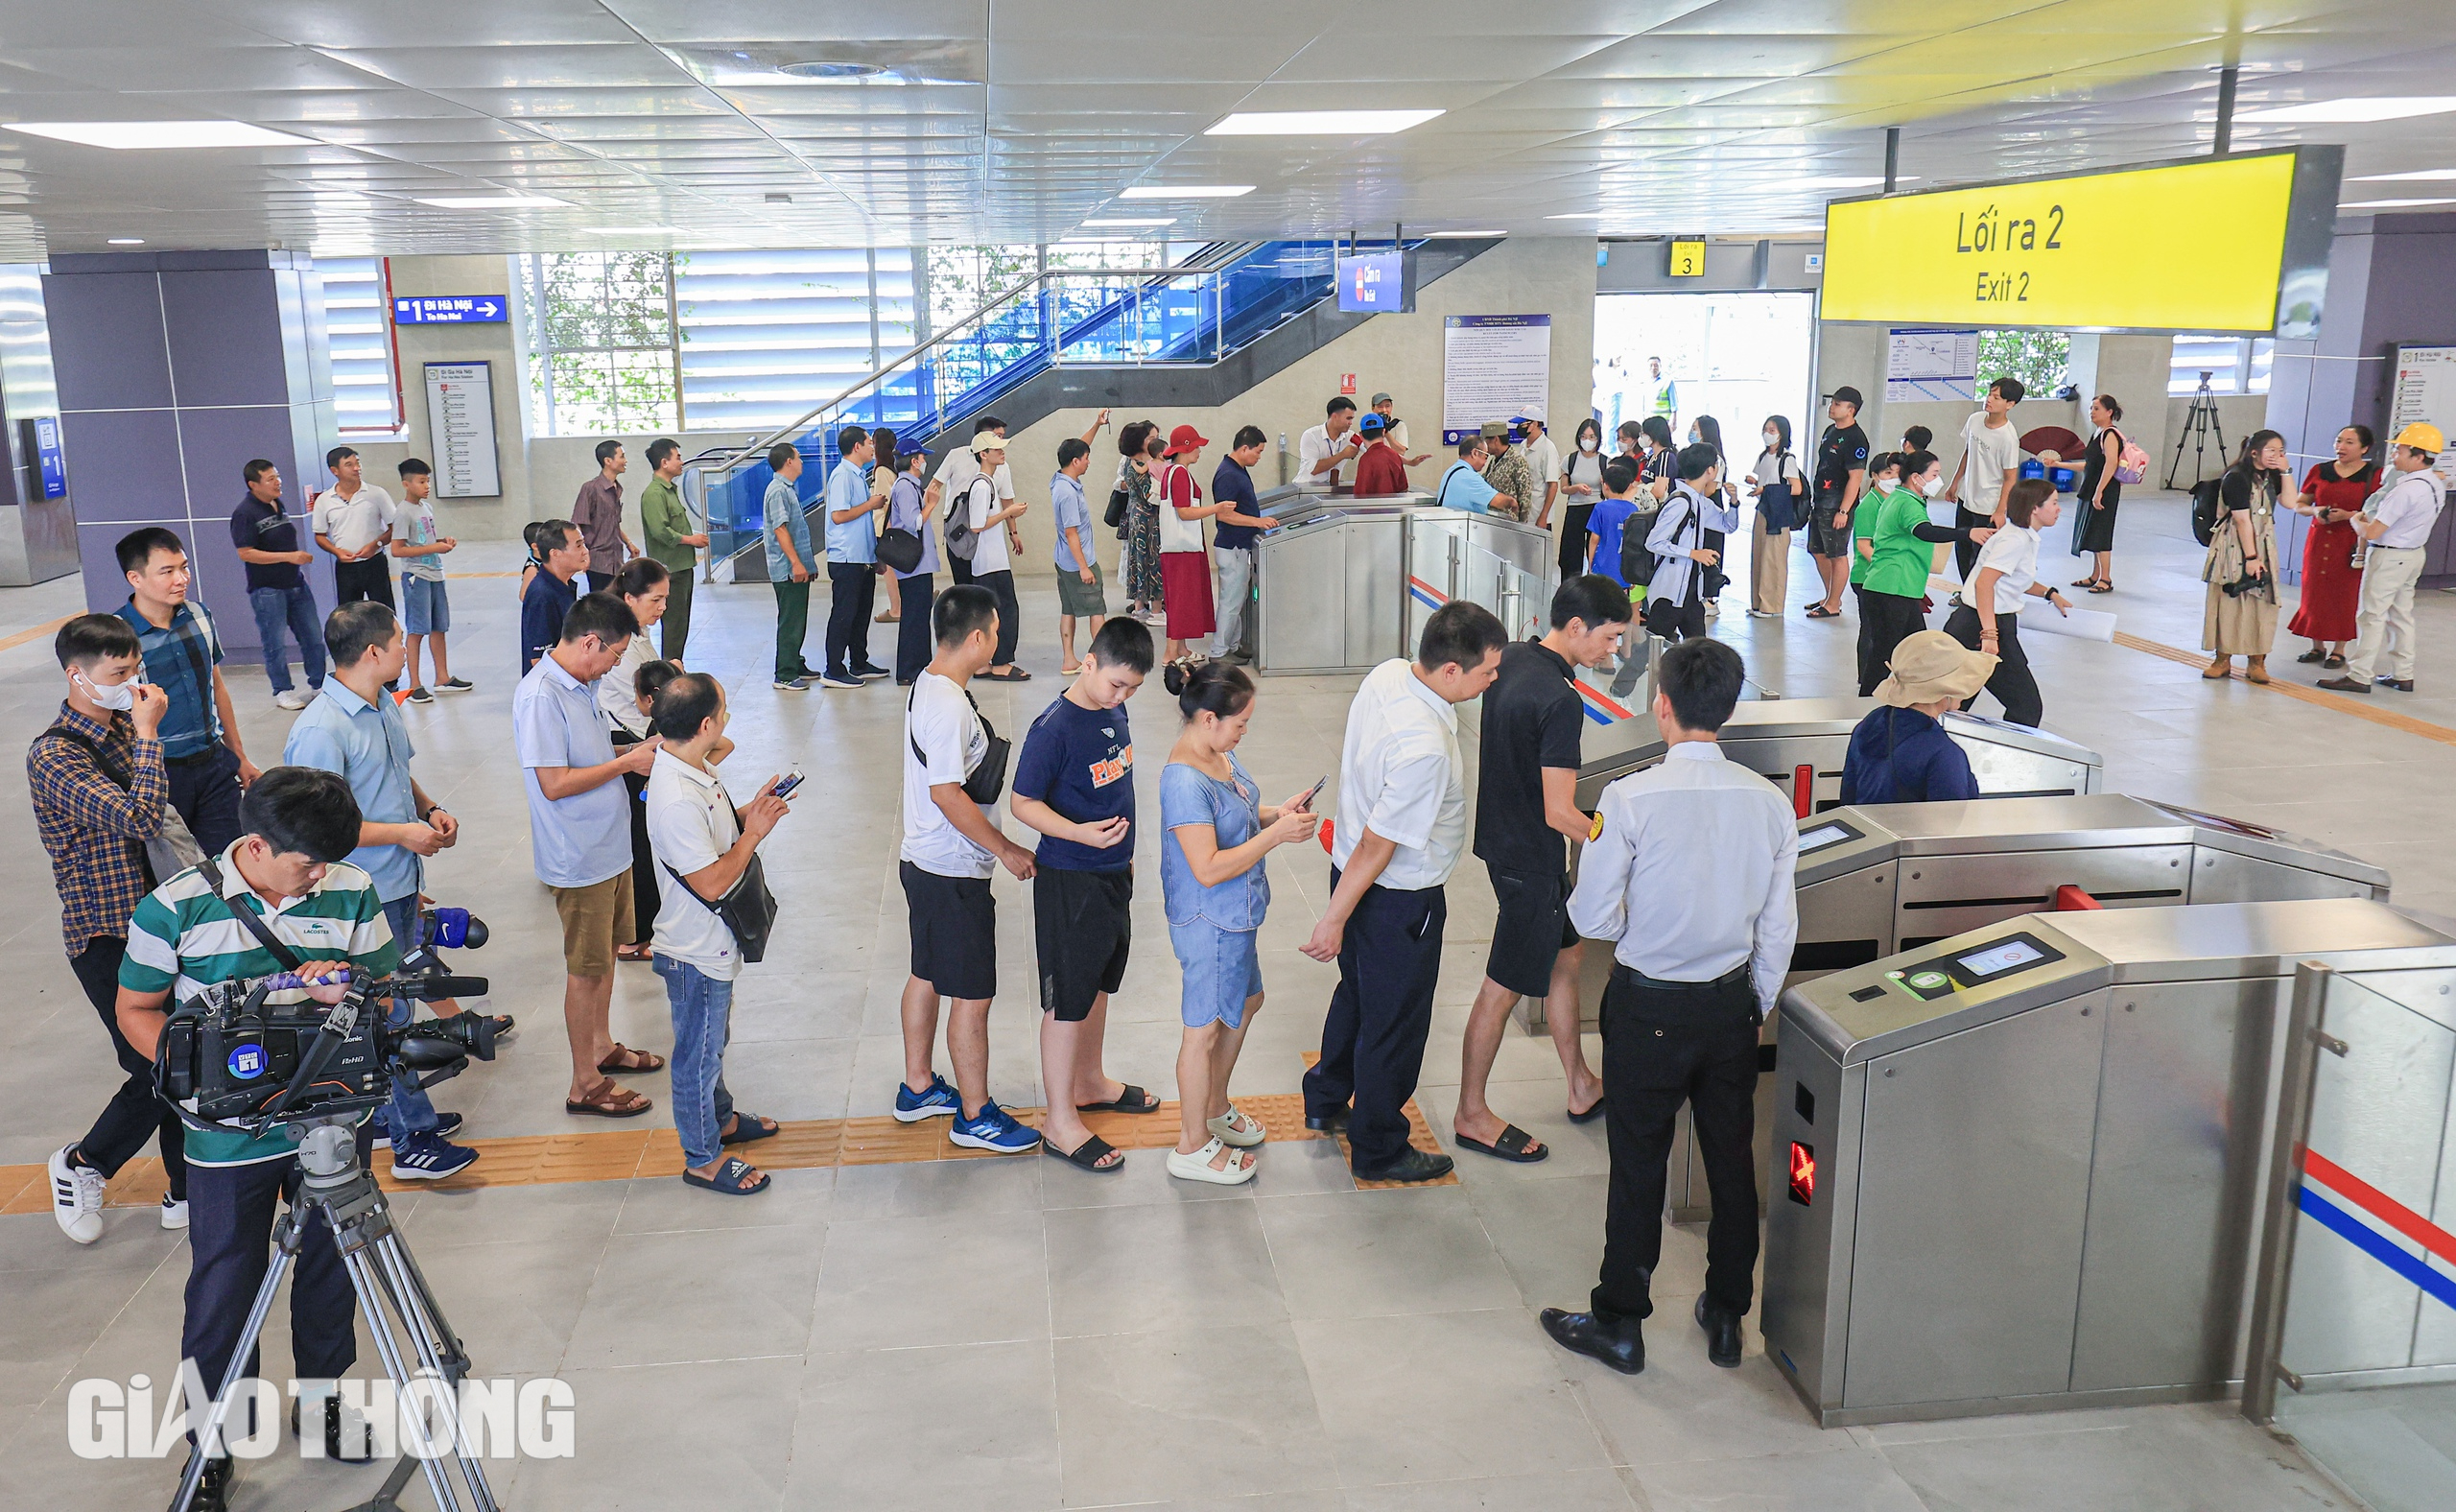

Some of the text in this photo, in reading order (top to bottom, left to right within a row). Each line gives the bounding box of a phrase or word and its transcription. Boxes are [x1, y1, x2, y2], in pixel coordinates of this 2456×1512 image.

[1957, 204, 2064, 252] Lối ra 2
[1683, 258, 1691, 274] 3
[1976, 272, 2029, 301] Exit 2
[412, 299, 473, 321] 1 Đi Hà Nội
[53, 455, 61, 476] 1
[1107, 744, 1122, 755] NFL
